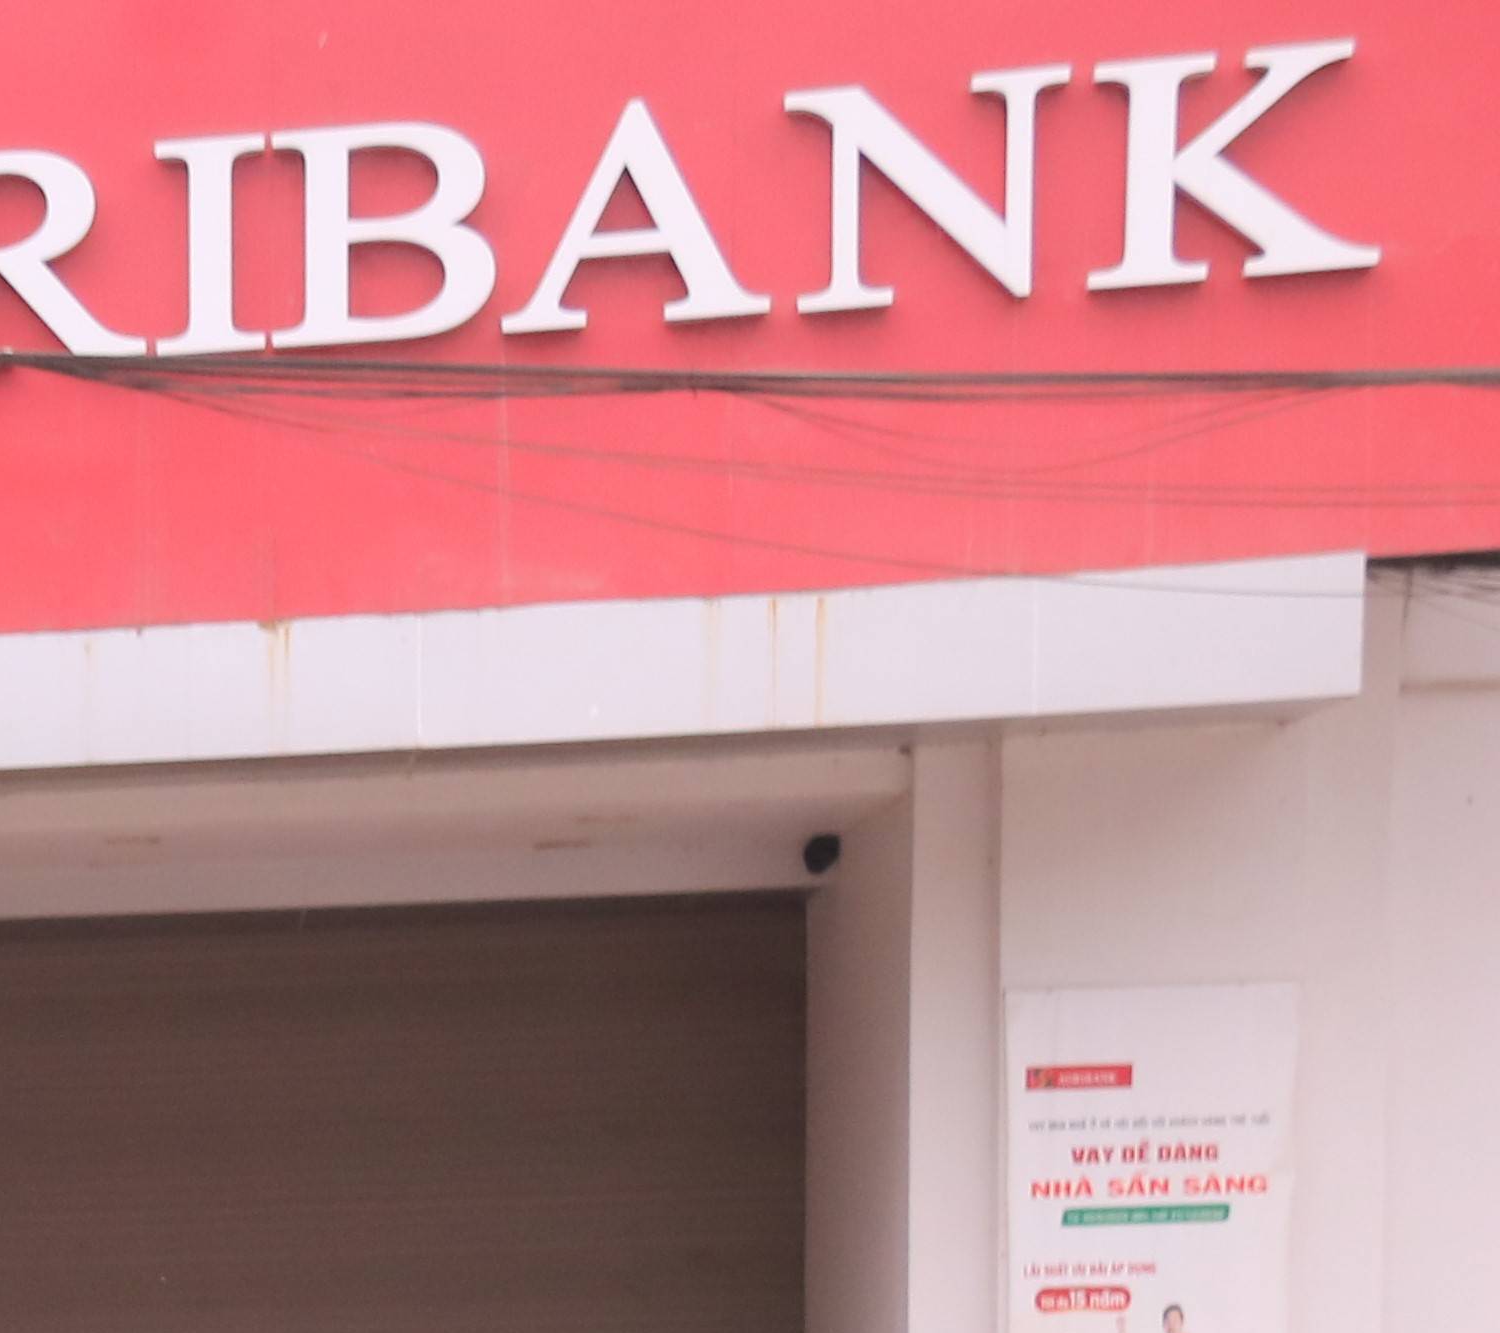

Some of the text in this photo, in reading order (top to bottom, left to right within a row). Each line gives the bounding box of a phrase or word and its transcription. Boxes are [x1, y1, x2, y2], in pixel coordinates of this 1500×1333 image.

[1071, 1145, 1116, 1165] VAY
[1157, 1142, 1220, 1163] DÀNG
[1029, 1174, 1095, 1199] NHÀ
[1183, 1172, 1269, 1196] SÀNG
